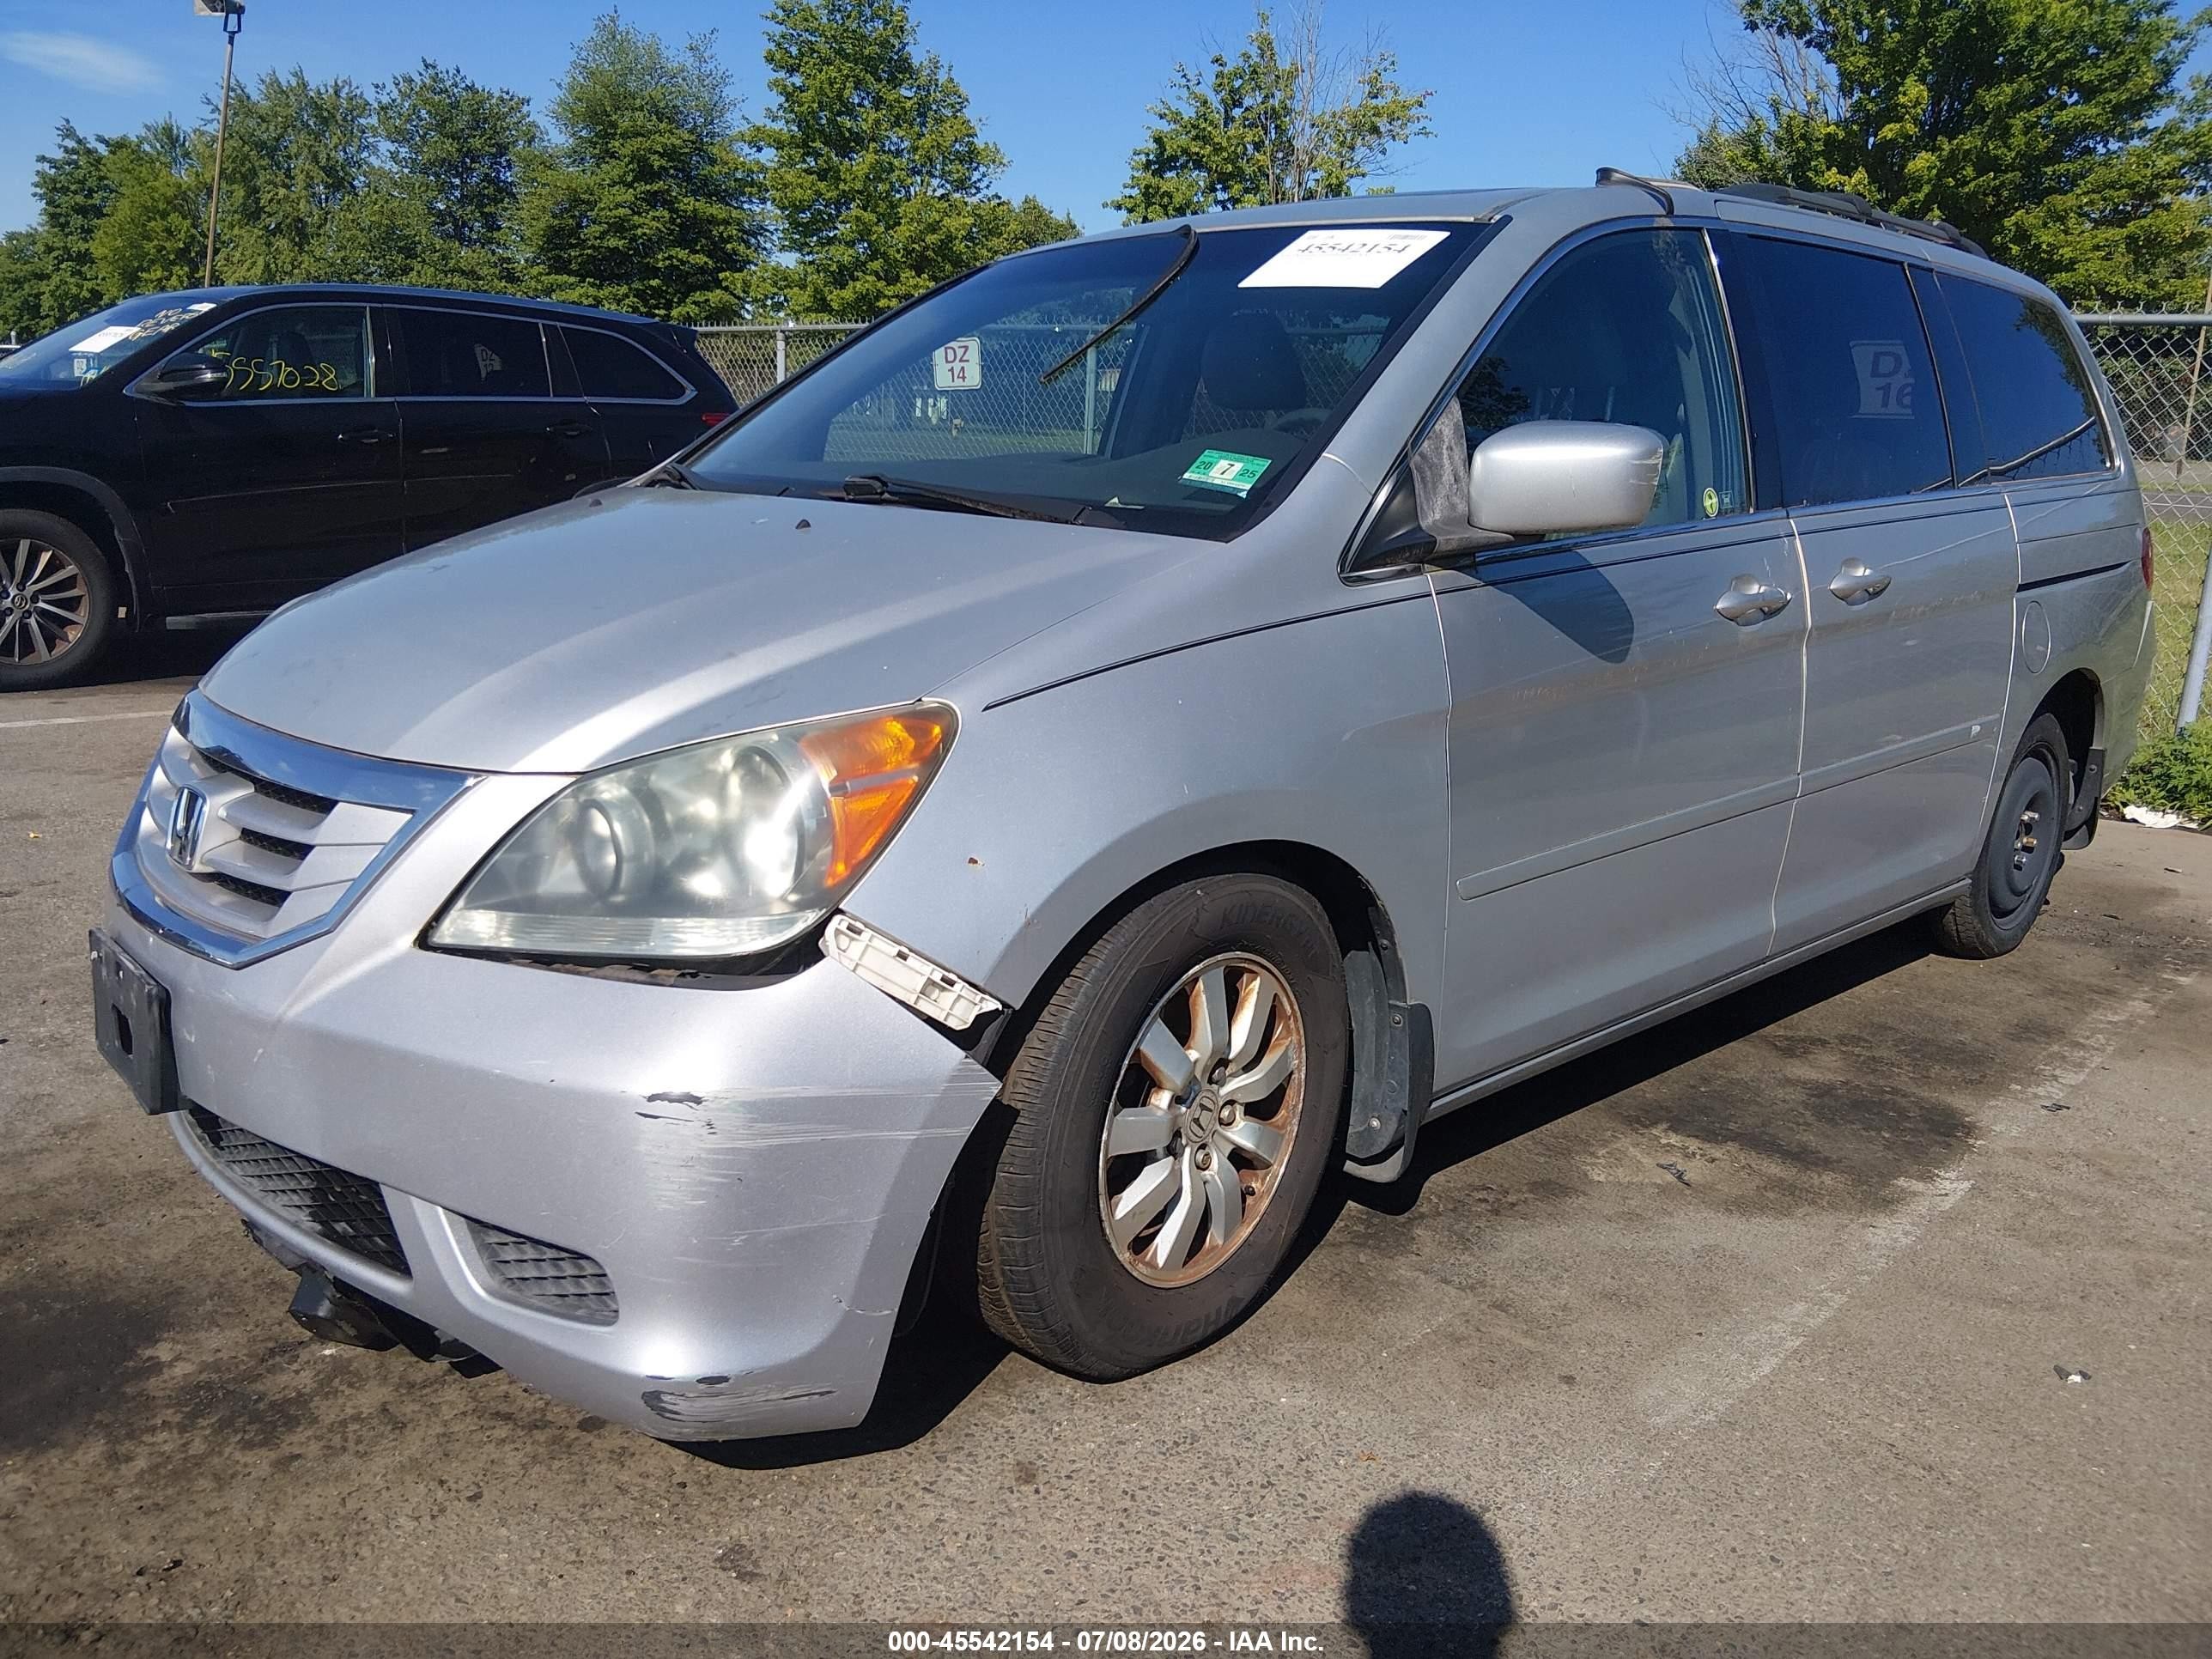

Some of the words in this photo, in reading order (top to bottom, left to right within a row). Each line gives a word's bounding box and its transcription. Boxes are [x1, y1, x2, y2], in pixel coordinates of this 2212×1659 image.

[155, 307, 182, 319] NO
[944, 345, 969, 363] DZ
[947, 366, 967, 383] 14
[1195, 460, 1213, 471] 20
[1220, 463, 1235, 476] 7
[1238, 468, 1259, 478] 25
